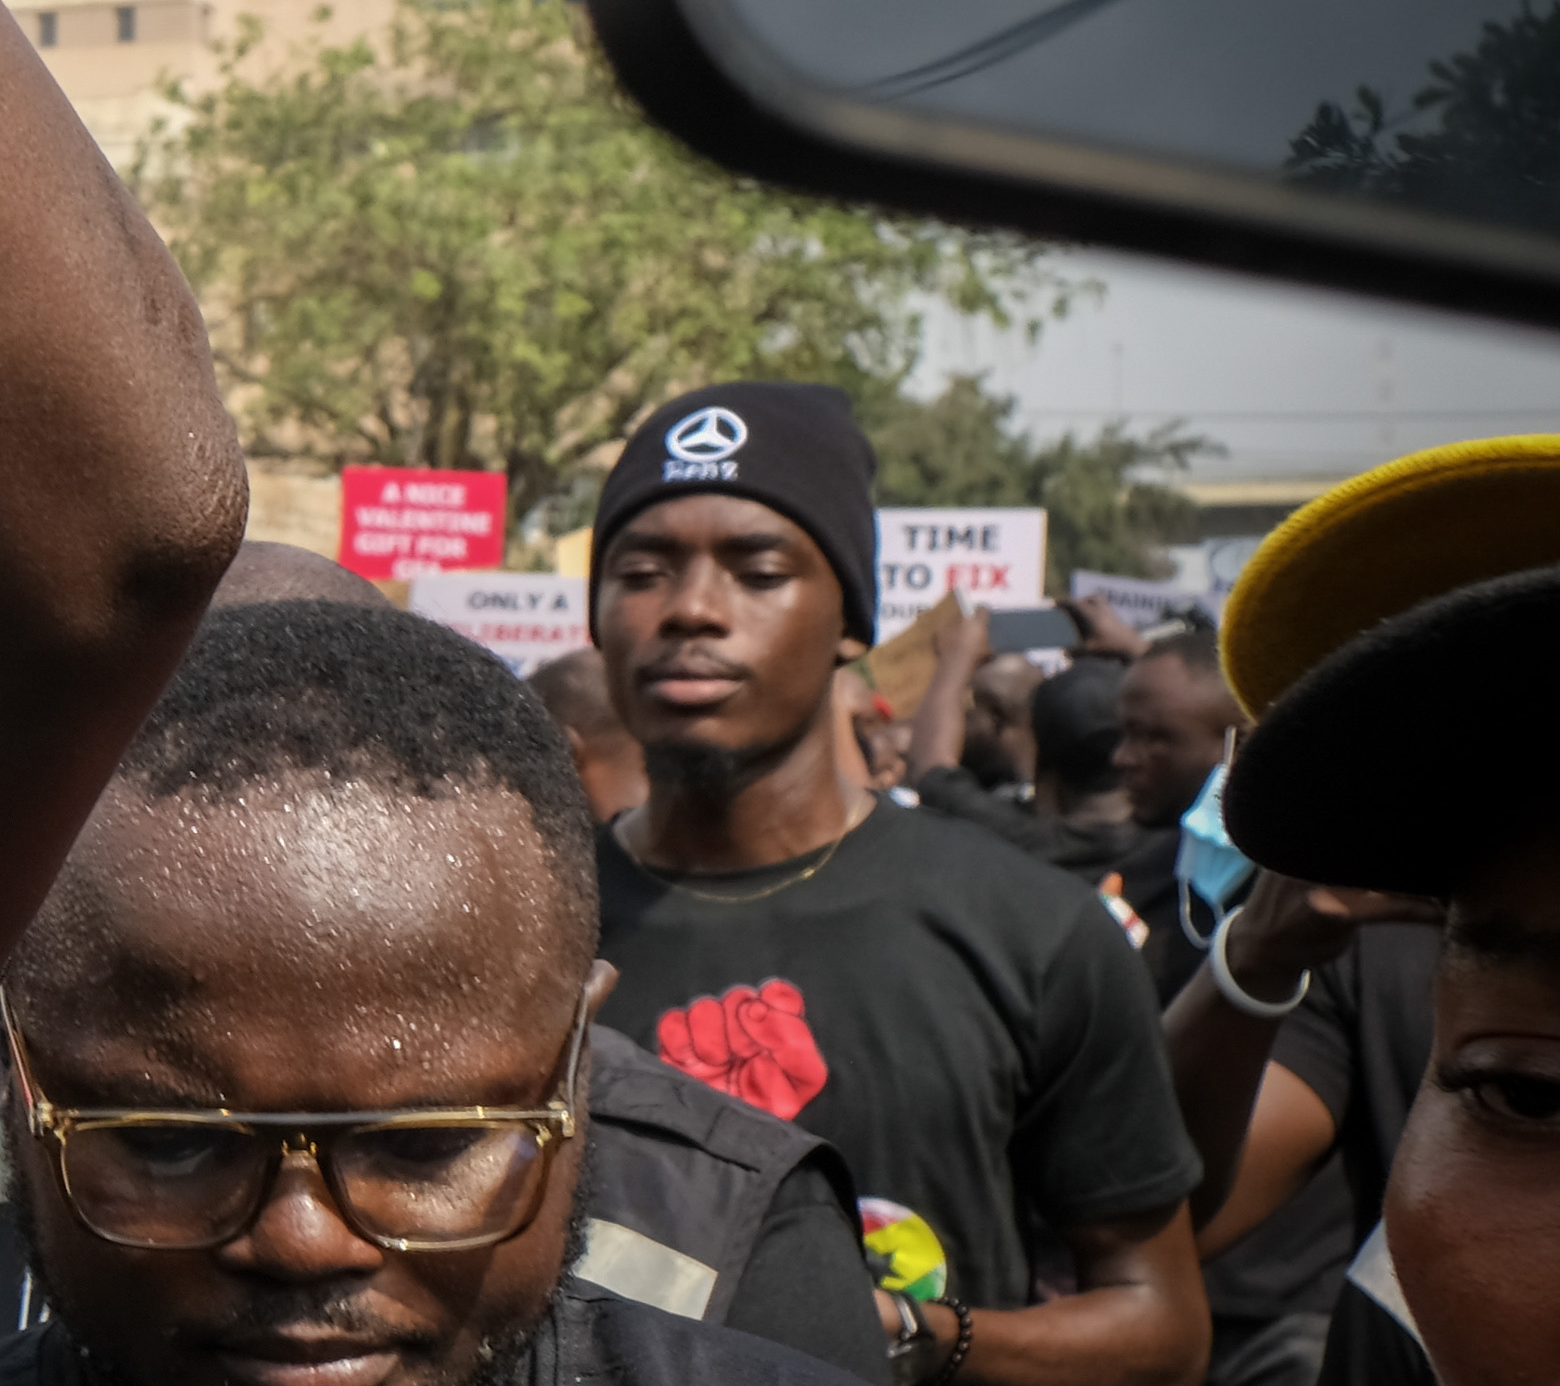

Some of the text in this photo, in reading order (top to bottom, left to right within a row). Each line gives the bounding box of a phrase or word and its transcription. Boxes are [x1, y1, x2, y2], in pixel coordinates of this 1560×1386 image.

[355, 507, 492, 538] VALENTINE
[353, 531, 467, 559] GIFT FOR
[904, 524, 1000, 552] TIME
[883, 563, 1010, 592] TO FIX
[469, 591, 569, 610] ONLY A
